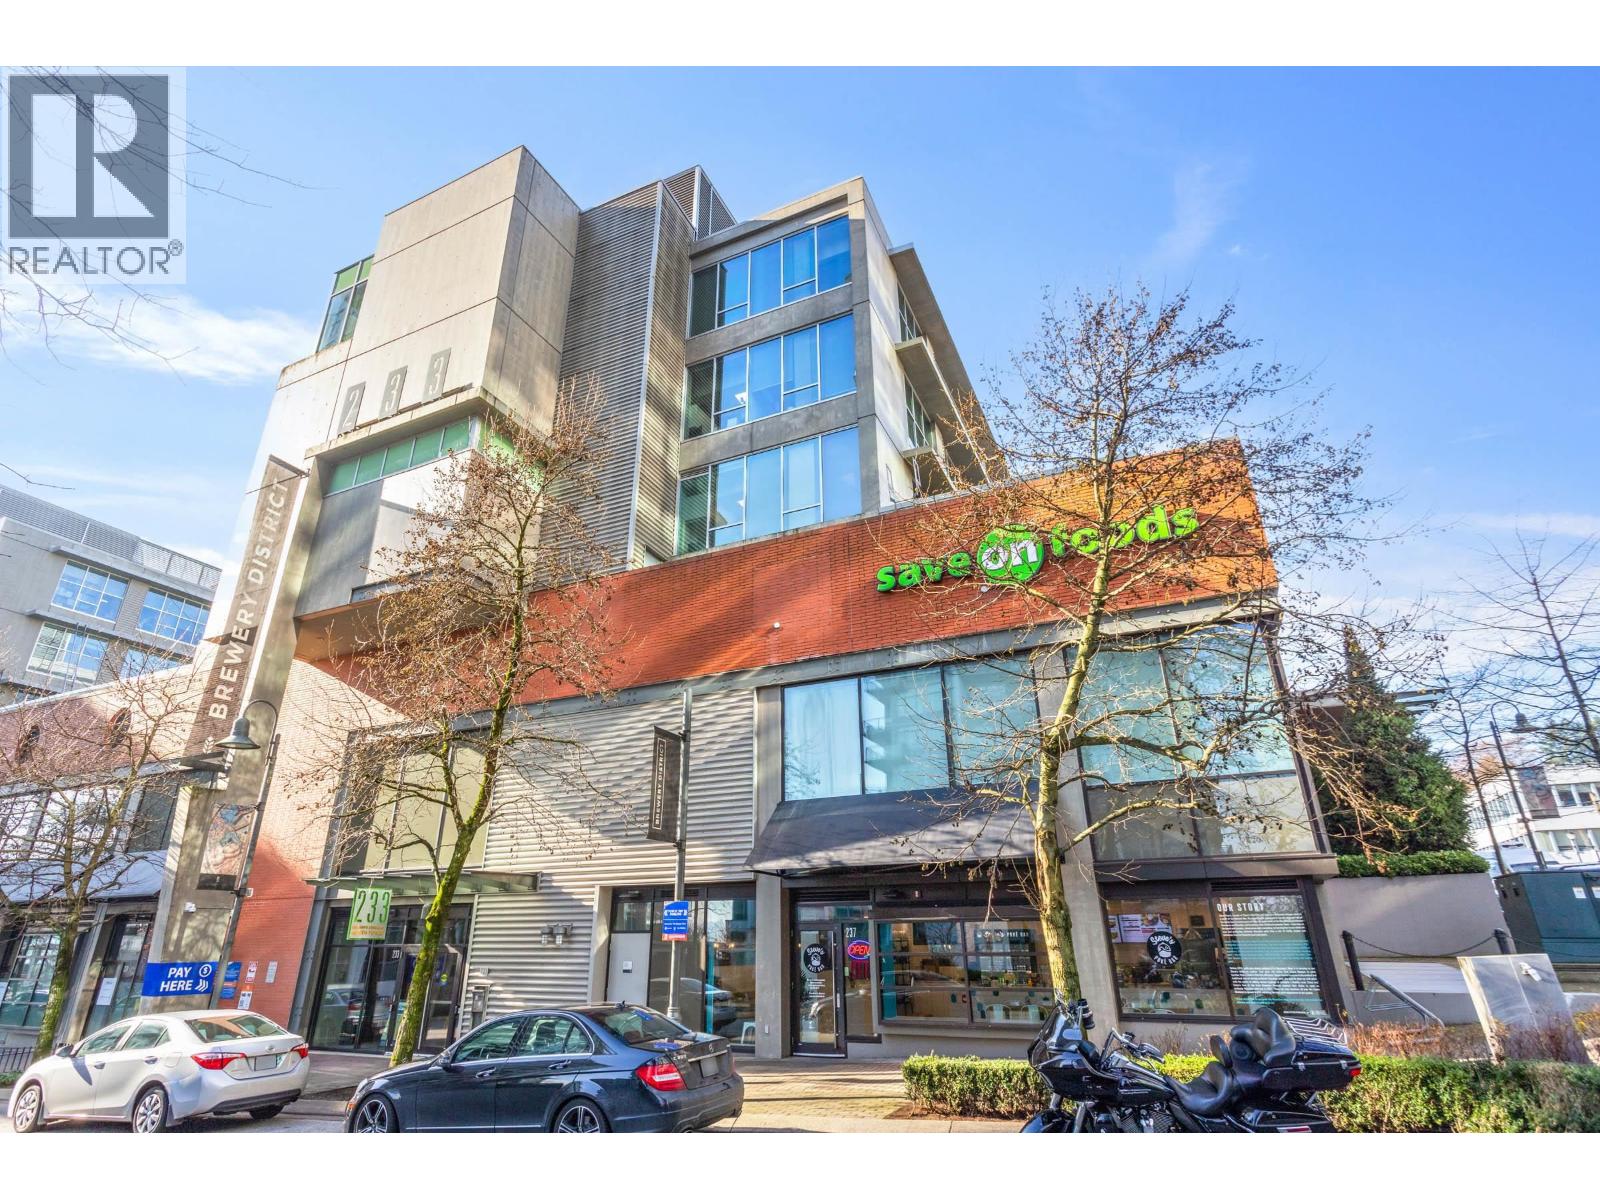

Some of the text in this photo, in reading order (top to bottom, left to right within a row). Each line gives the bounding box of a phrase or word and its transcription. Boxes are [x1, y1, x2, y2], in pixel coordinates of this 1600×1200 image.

[339, 352, 448, 434] 233
[876, 551, 972, 592] save
[981, 538, 1040, 570] on
[208, 478, 288, 720] BREWERY DISTRICT
[353, 890, 390, 923] 233
[1216, 902, 1264, 912] OUR STORY
[845, 927, 857, 938] 237
[850, 944, 870, 955] OPEN
[167, 966, 193, 979] PAY
[159, 979, 193, 992] HERE
